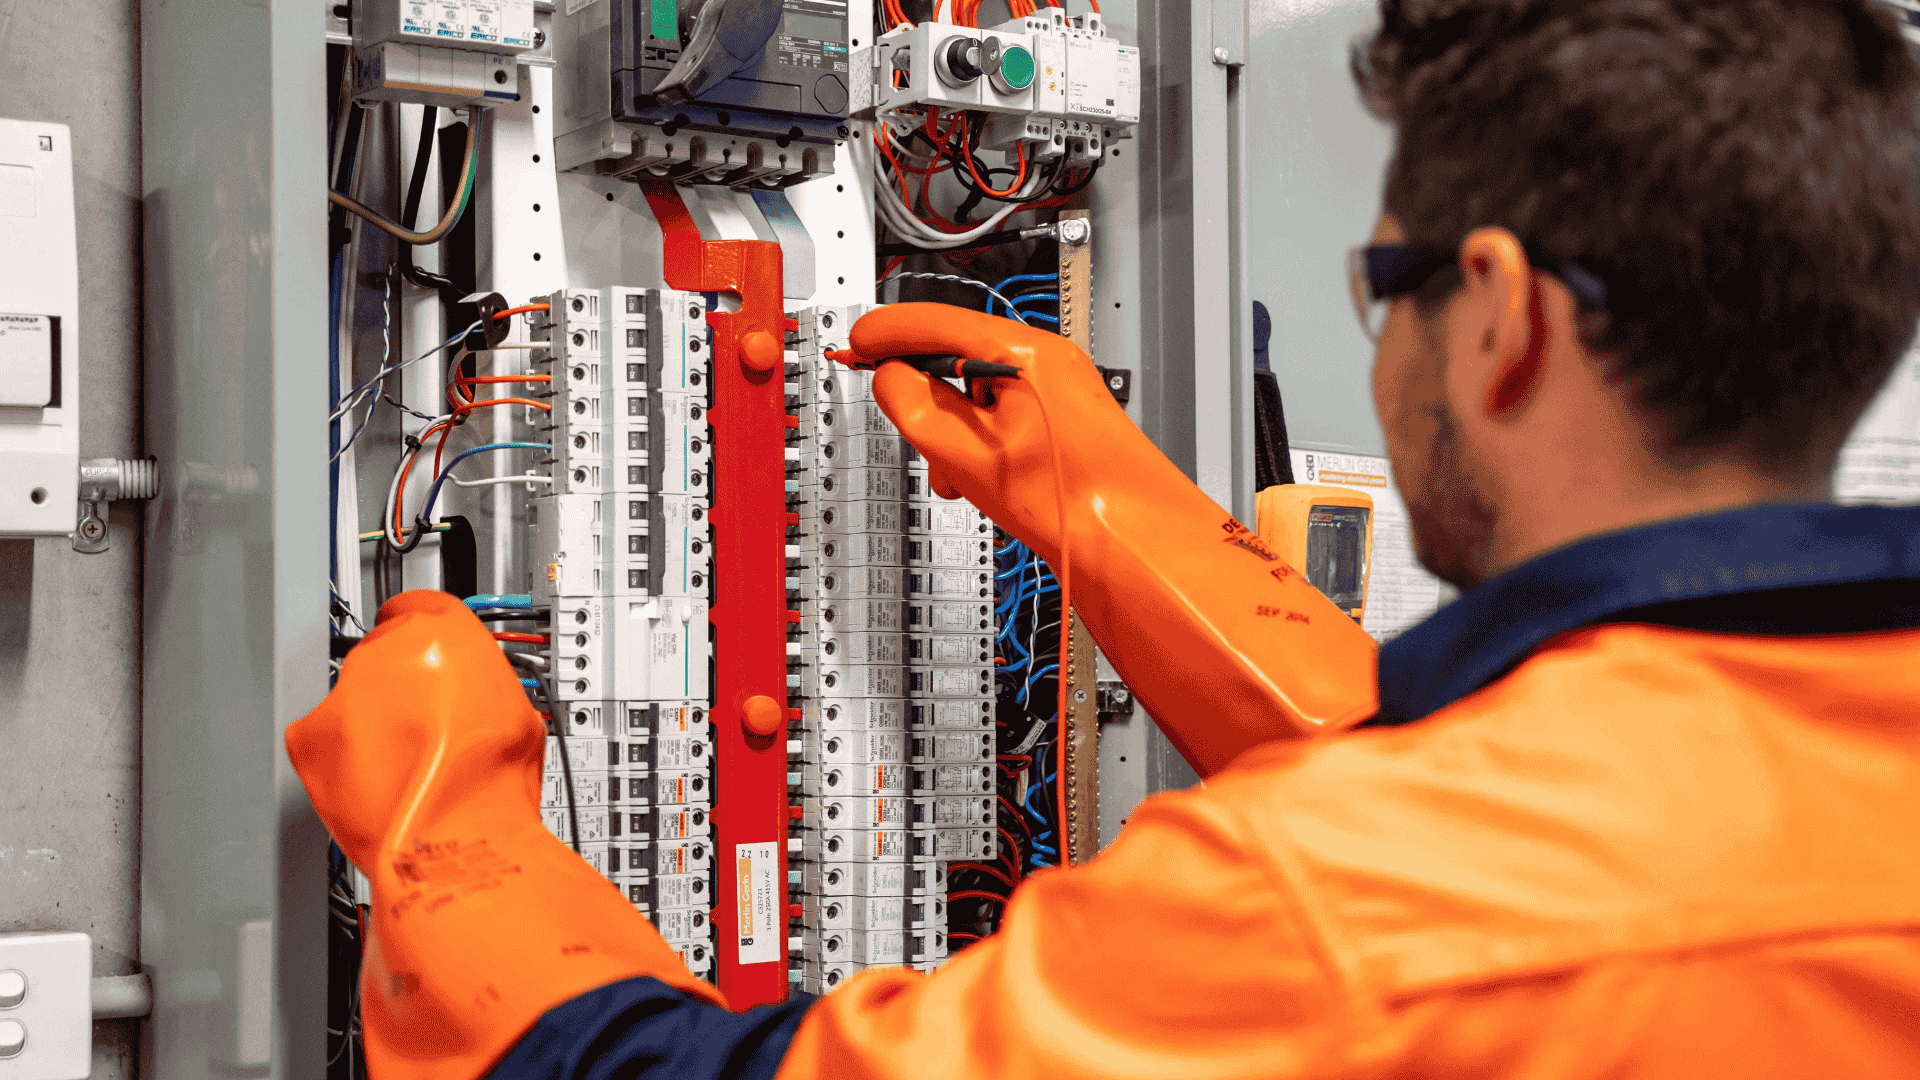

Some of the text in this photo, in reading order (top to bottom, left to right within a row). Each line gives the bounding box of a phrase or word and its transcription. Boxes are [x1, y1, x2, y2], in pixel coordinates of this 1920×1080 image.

[86, 468, 113, 476] CLIPSA
[1317, 455, 1355, 472] MERLIN
[742, 875, 752, 934] Merlin Gerin
